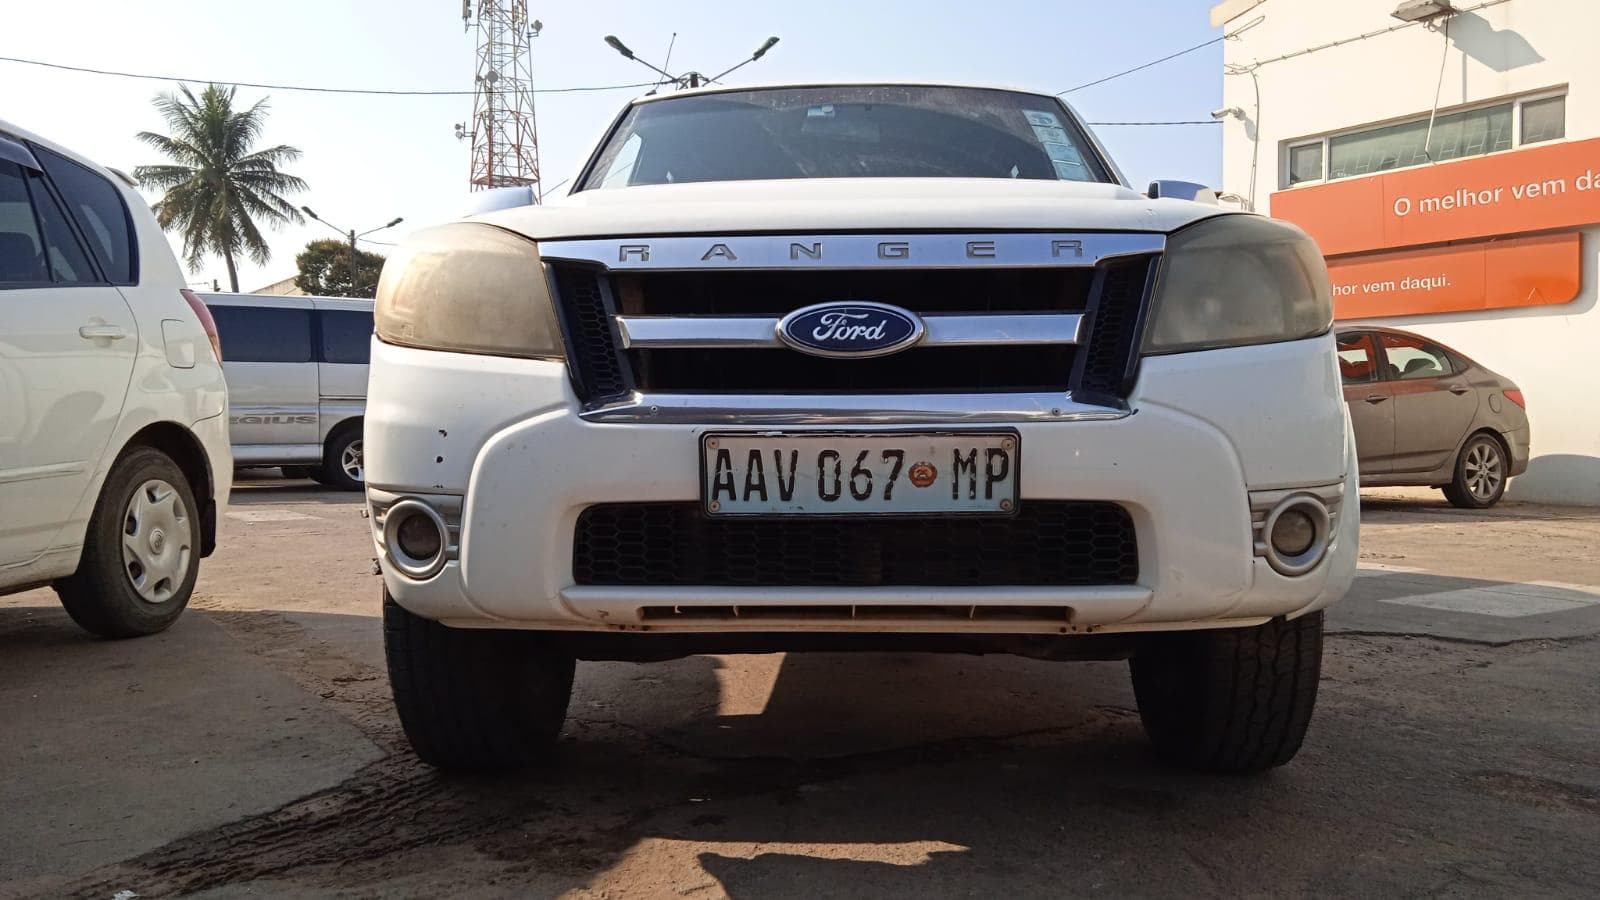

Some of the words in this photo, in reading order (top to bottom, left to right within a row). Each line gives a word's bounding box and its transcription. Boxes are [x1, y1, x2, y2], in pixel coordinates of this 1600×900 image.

[1393, 197, 1411, 216] O
[1419, 186, 1503, 213] melhor
[1511, 179, 1566, 200] vem
[619, 239, 1084, 263] RANGER
[1362, 280, 1395, 294] vem
[1400, 273, 1451, 291] daqui.
[812, 311, 886, 342] Ford
[712, 448, 799, 501] AAV
[817, 449, 905, 501] 067
[952, 447, 1009, 500] MP
